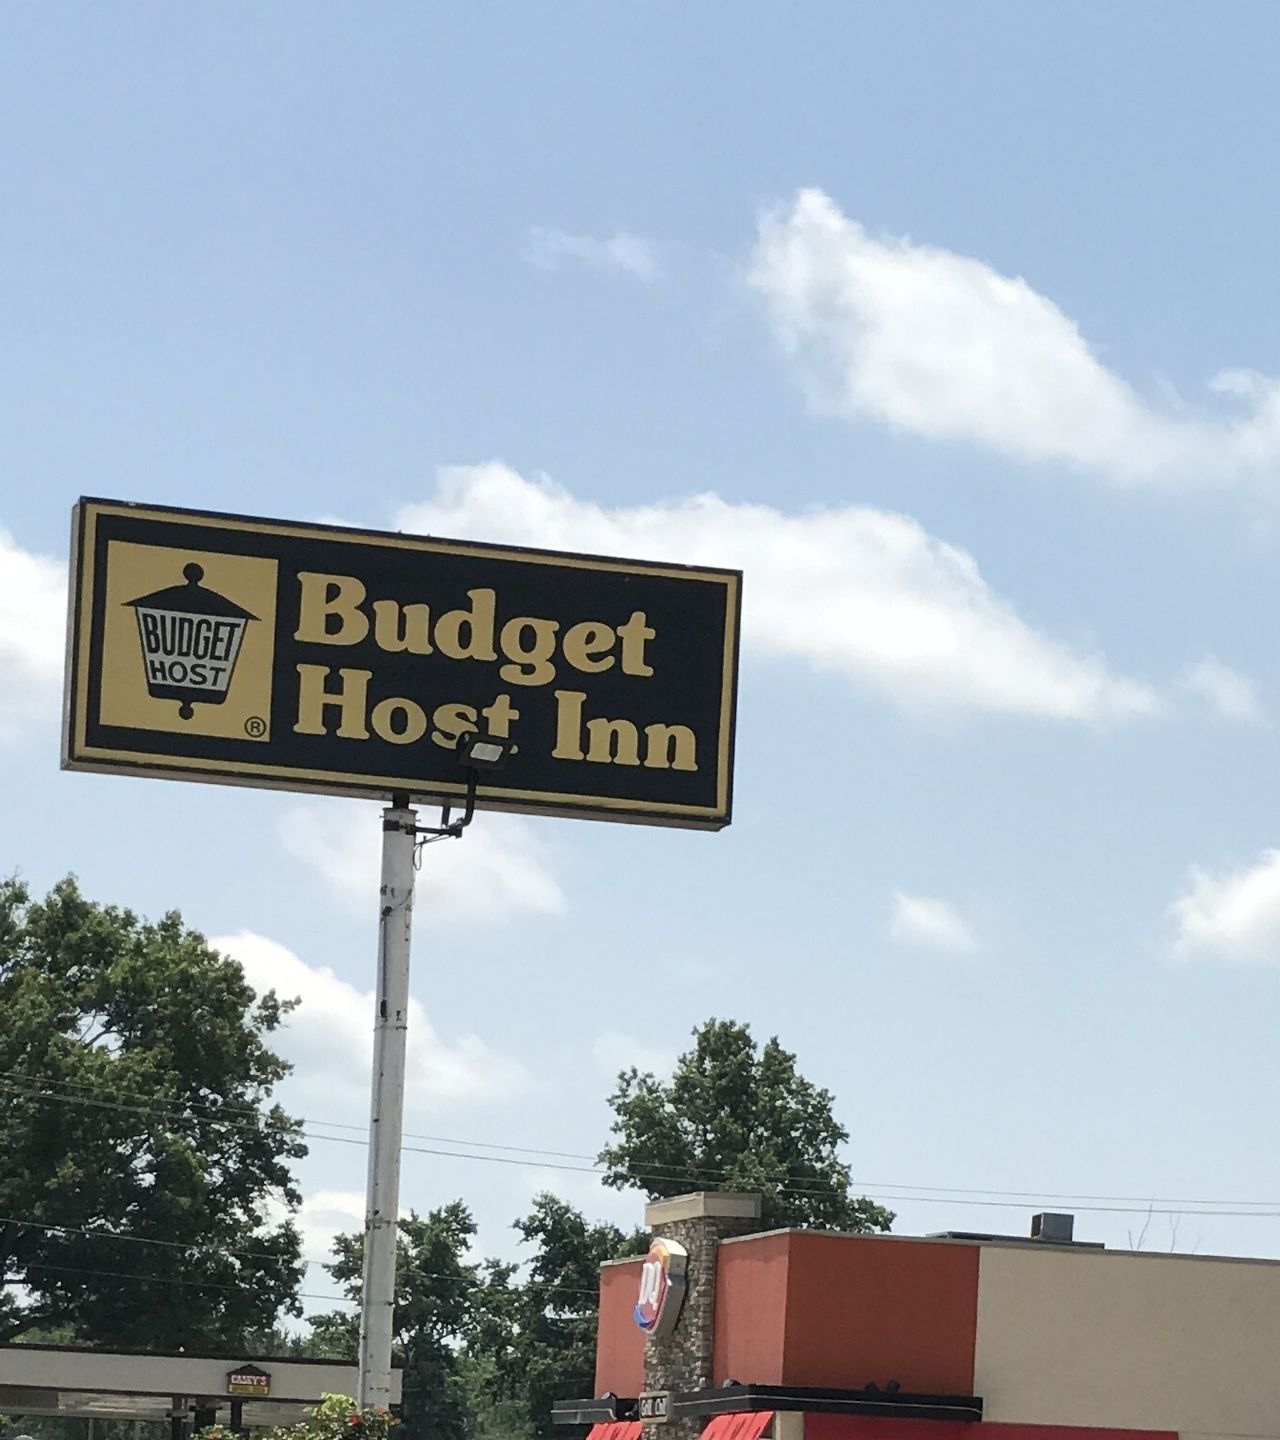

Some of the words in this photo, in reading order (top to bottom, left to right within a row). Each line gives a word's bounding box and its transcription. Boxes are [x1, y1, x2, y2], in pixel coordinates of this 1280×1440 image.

[142, 613, 241, 662] BUDGET
[294, 572, 656, 686] Budget
[149, 659, 227, 687] HOST
[294, 664, 520, 752] Host
[552, 690, 698, 771] Inn
